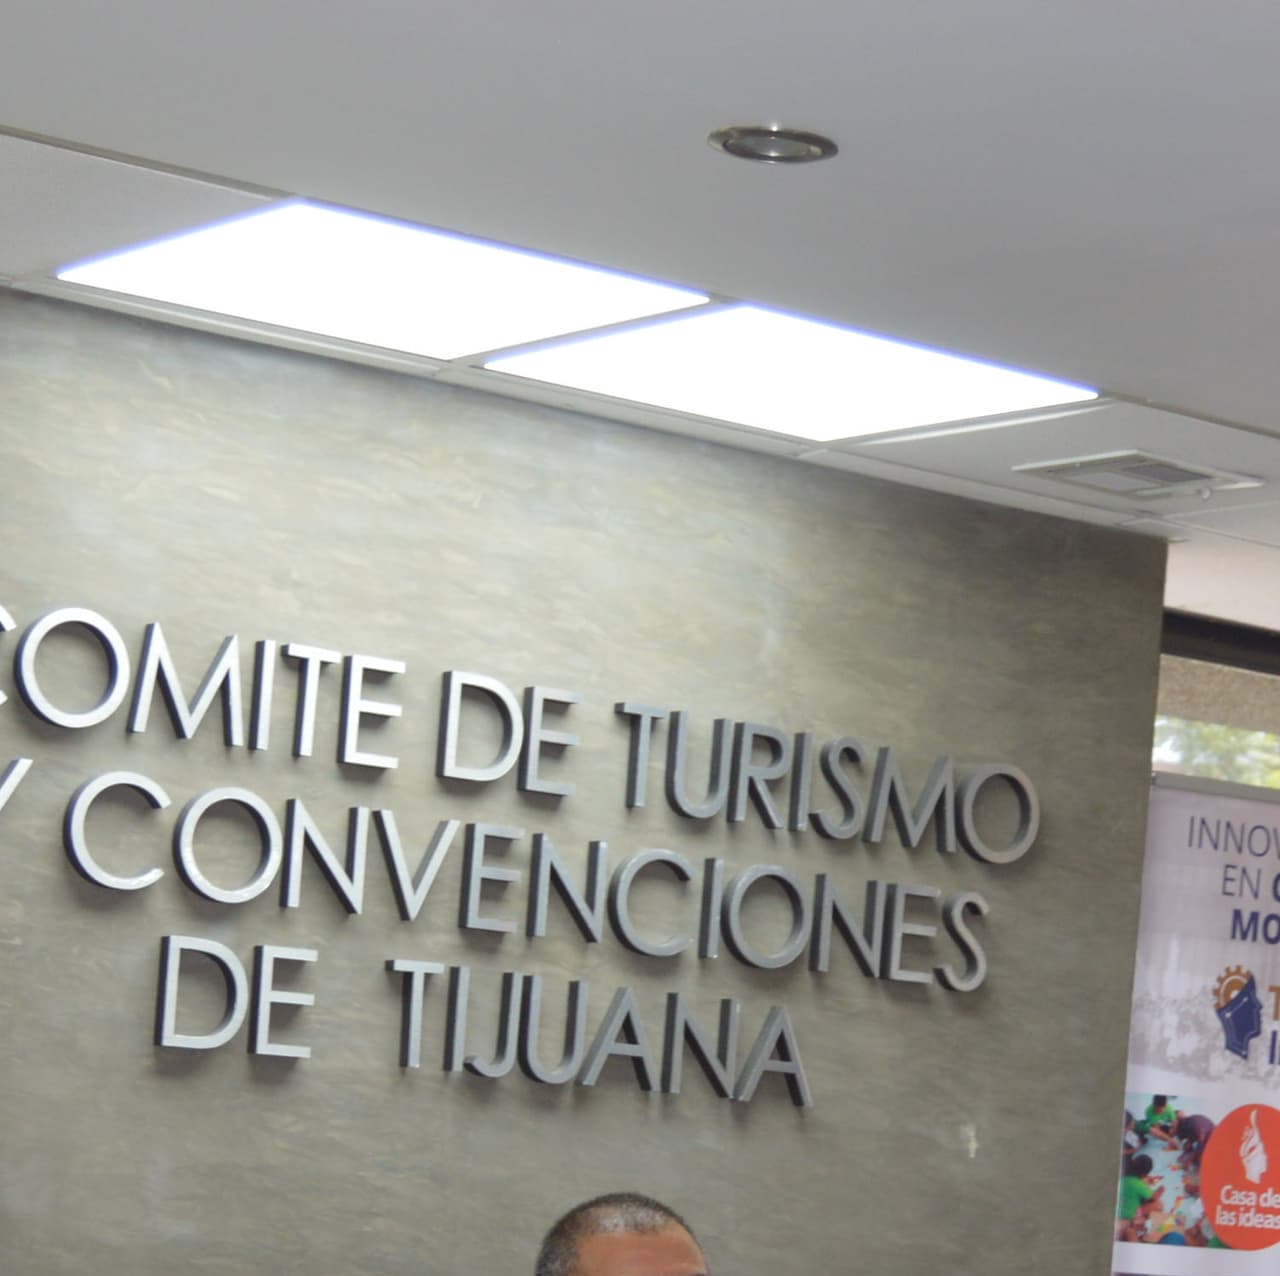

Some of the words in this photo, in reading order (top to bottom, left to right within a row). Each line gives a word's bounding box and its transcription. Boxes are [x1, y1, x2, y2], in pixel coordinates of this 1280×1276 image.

[436, 669, 580, 797] DE
[615, 701, 1041, 864] TURISMO
[62, 771, 990, 992] CONVENCIONES
[1221, 864, 1262, 900] EN
[154, 935, 320, 1058] DE
[385, 958, 813, 1107] TIJUANA
[1215, 1206, 1237, 1226] las
[1220, 1185, 1256, 1207] Casa
